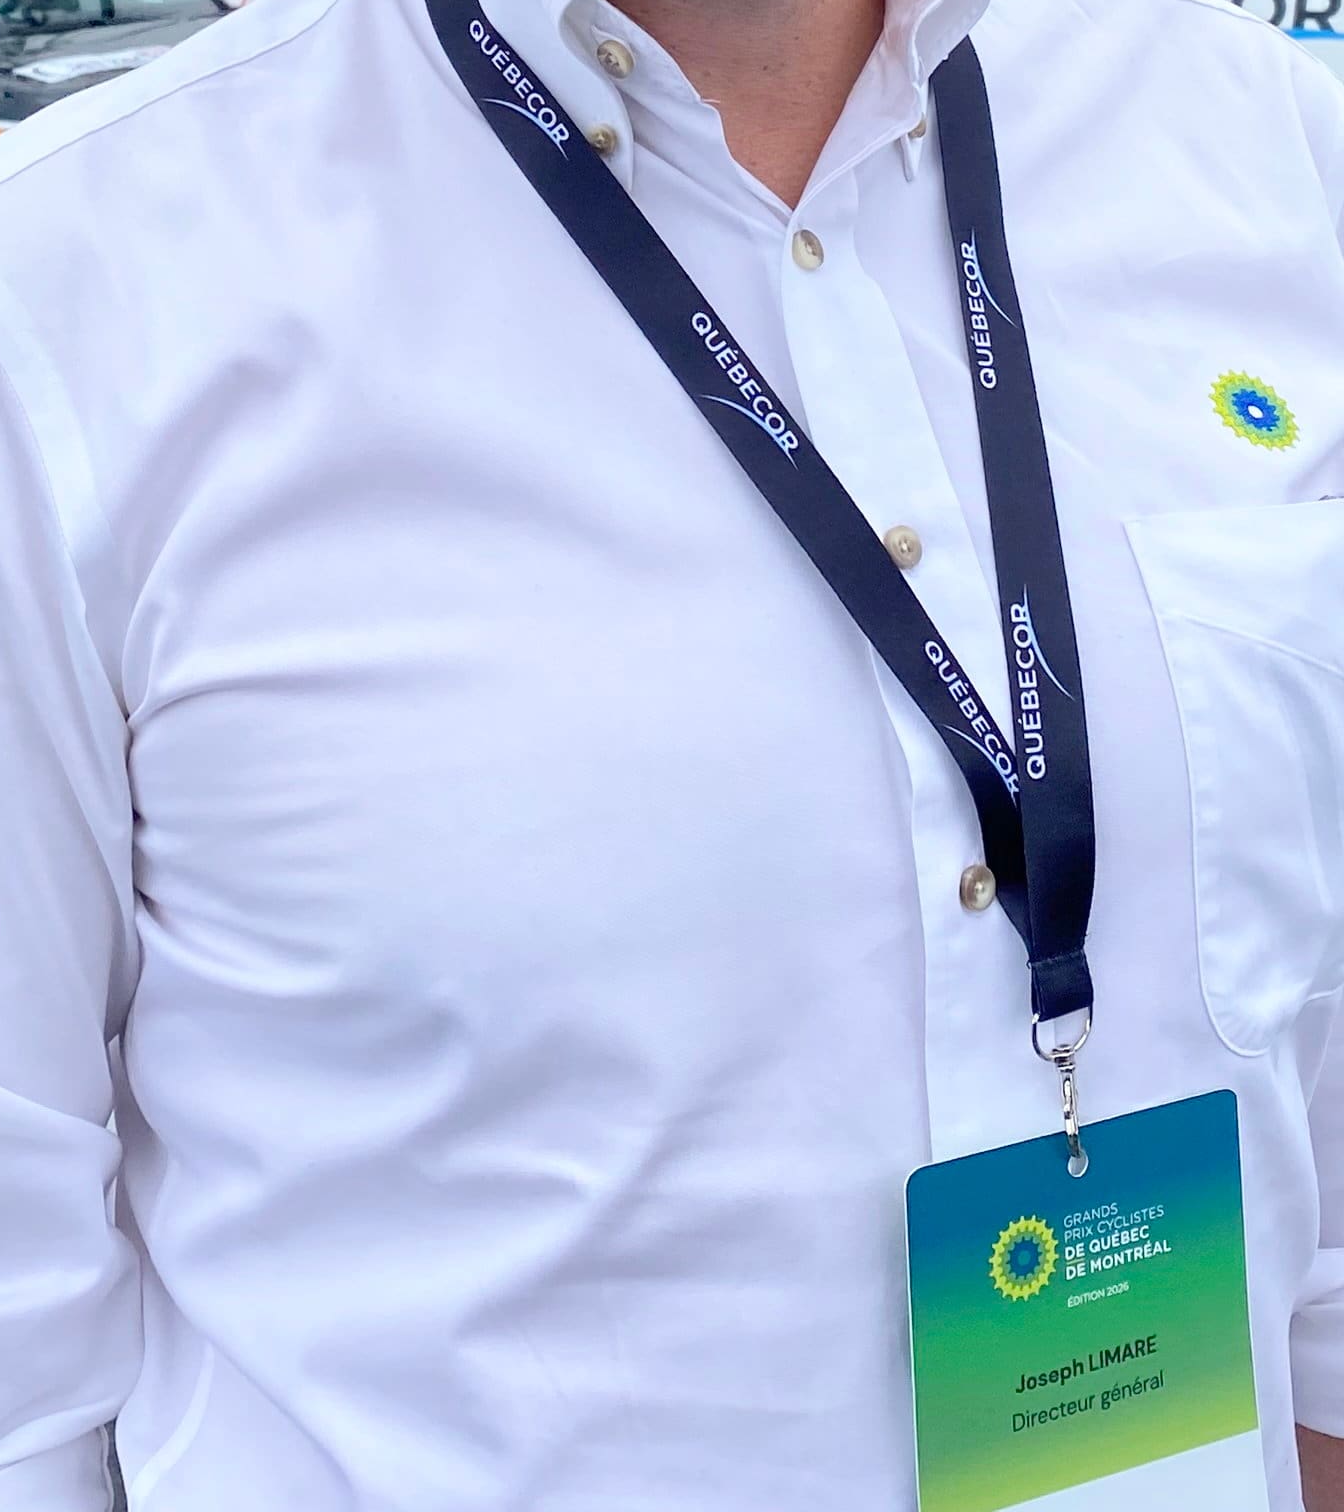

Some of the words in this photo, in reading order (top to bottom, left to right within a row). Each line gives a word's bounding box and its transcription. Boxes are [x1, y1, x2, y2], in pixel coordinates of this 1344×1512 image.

[469, 19, 570, 144] QUÉBECOR
[960, 242, 998, 389] QUÉBECOR
[691, 312, 799, 451] QUÉBECOR
[1010, 602, 1046, 780] QUÉBECOR
[1063, 1202, 1119, 1228] GRANDS
[1064, 1225, 1094, 1243] PRIX
[1096, 1204, 1165, 1234] CYCLISTES
[1064, 1242, 1086, 1261] DE
[1089, 1225, 1150, 1253] QUÉBEC
[1065, 1262, 1087, 1281] DE
[1090, 1239, 1172, 1273] MONTRÉAL
[1067, 1287, 1106, 1308] ÉDITION
[1015, 1358, 1085, 1394] Joseph
[1088, 1334, 1158, 1372] LIMARE
[1012, 1394, 1096, 1433] Directeur
[1100, 1369, 1165, 1410] général
